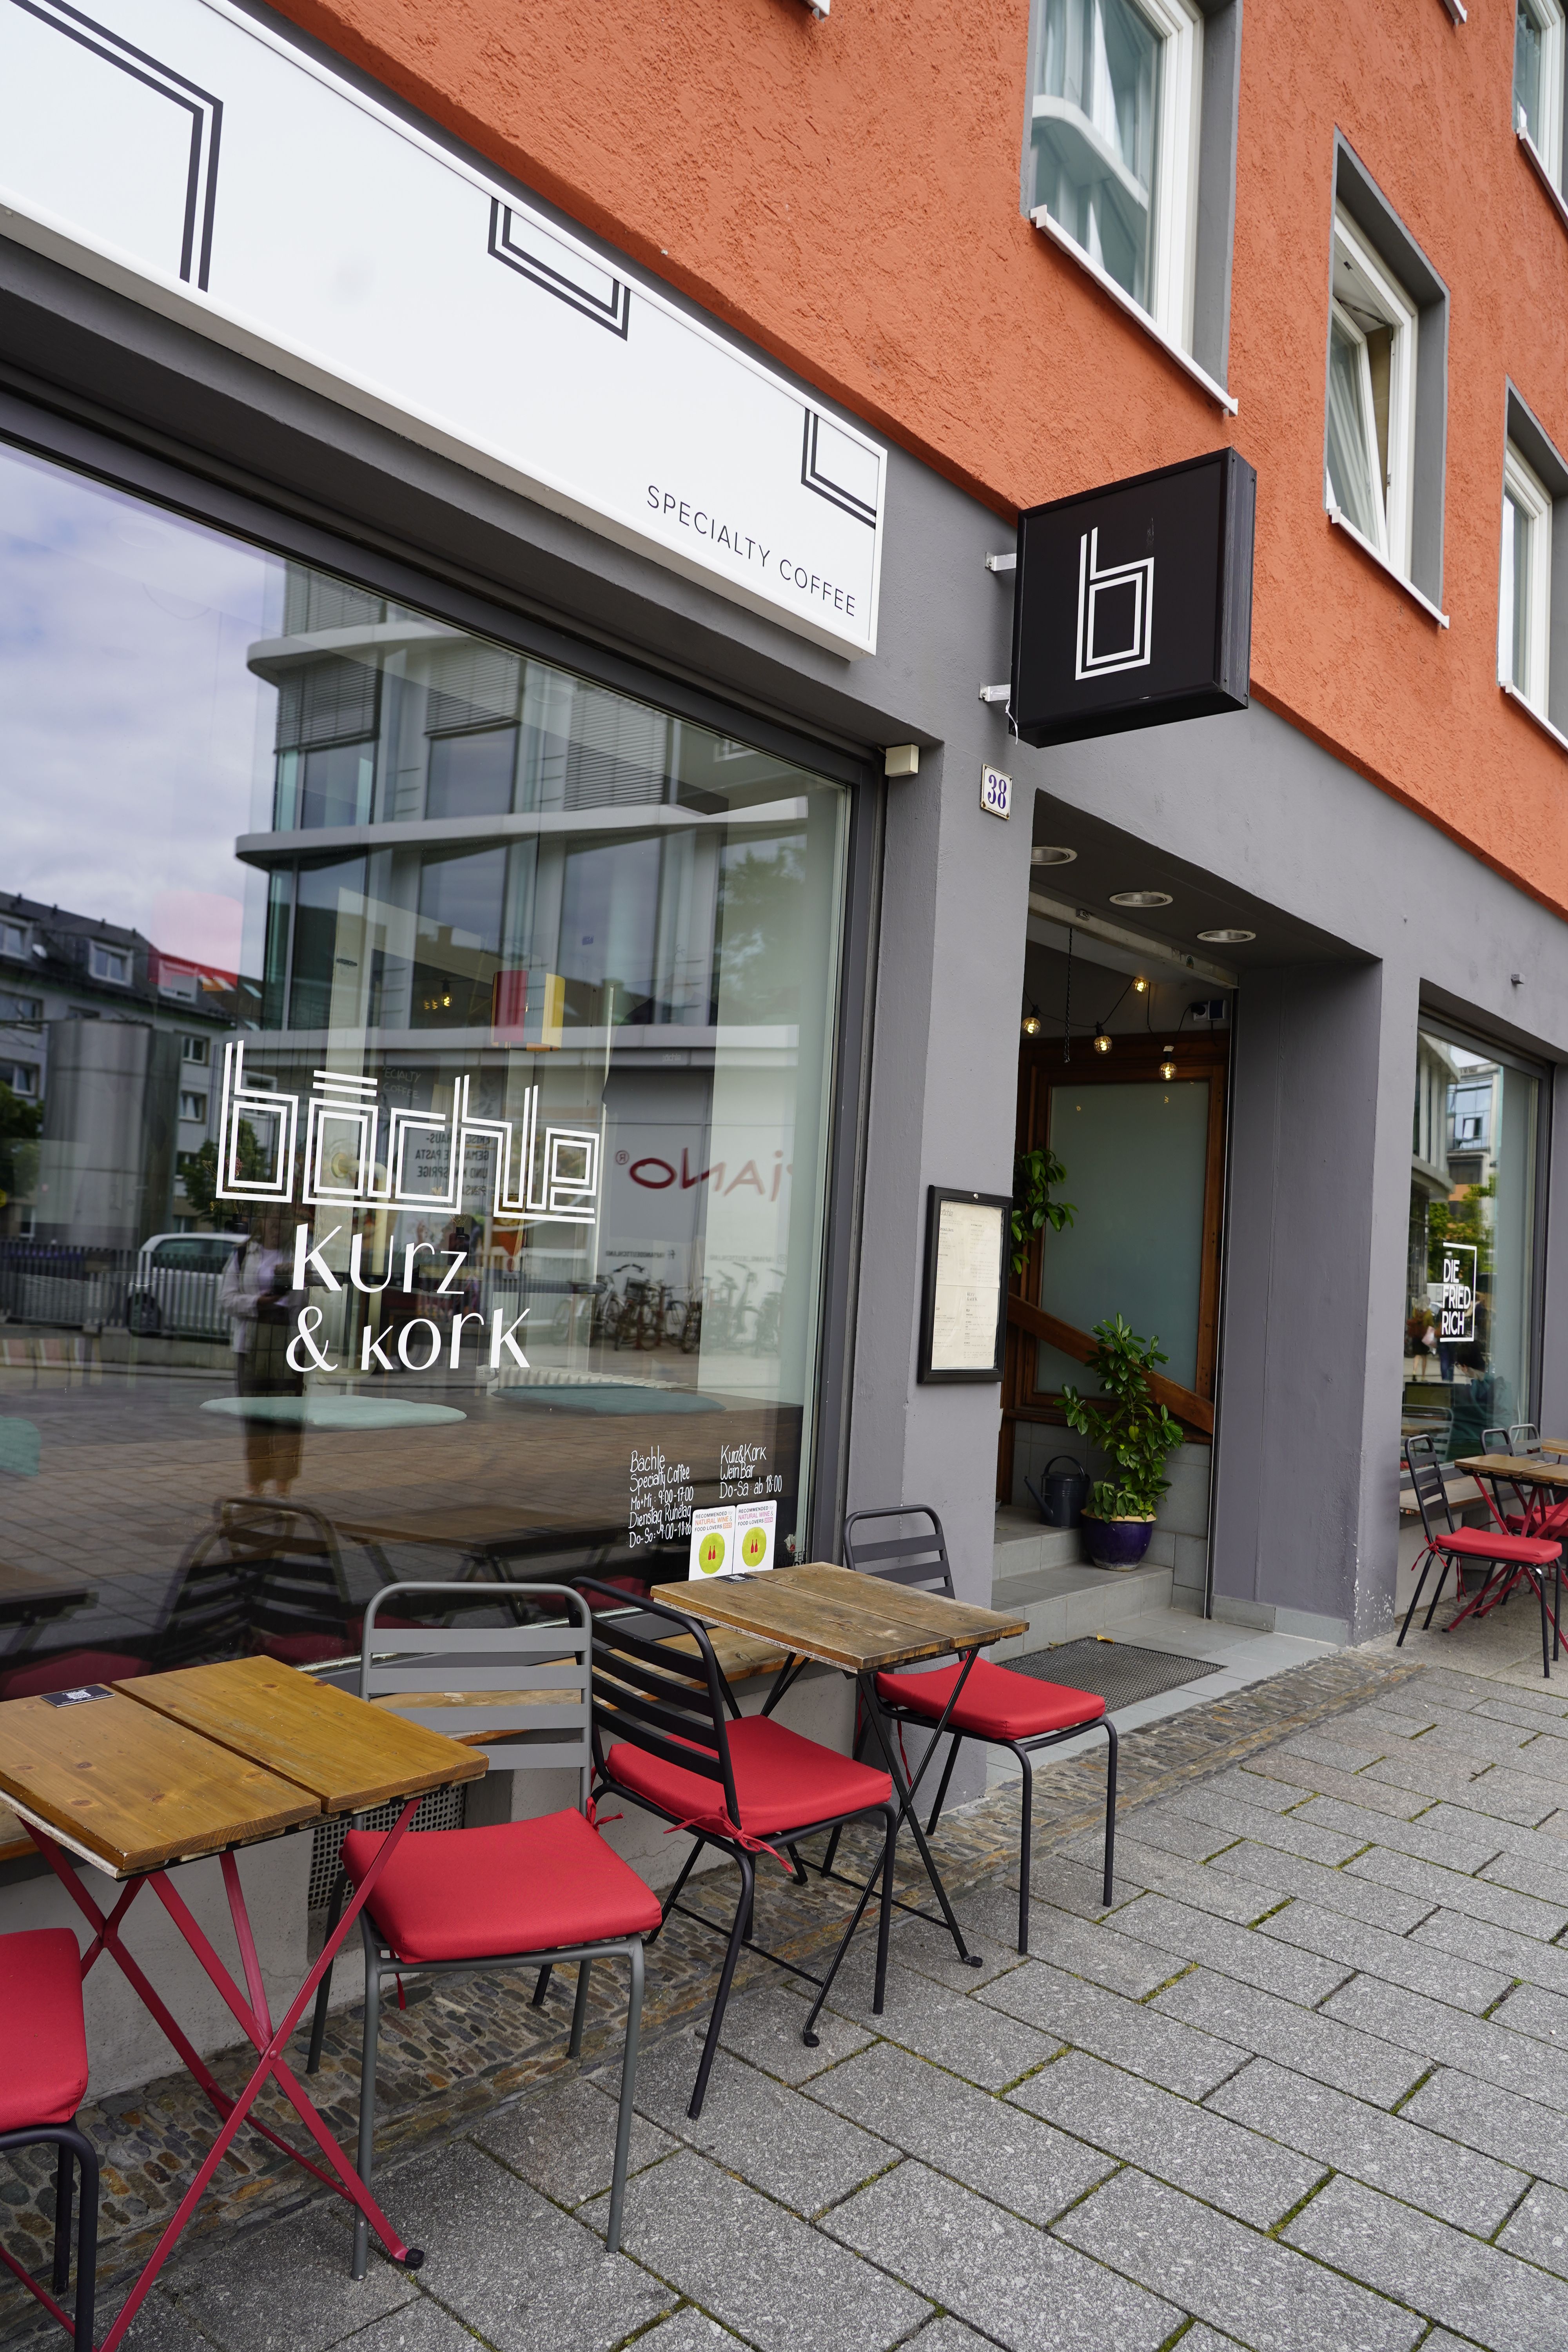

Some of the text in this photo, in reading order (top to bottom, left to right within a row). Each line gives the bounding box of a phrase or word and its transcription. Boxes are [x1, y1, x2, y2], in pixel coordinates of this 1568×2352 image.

[647, 485, 856, 617] SPECIALTY COFFEE
[987, 775, 1007, 809] 38
[383, 1065, 421, 1083] ECIALTY
[1443, 1259, 1460, 1283] DIE
[1443, 1285, 1471, 1309] FRIED
[1441, 1311, 1465, 1335] RICH
[286, 1305, 338, 1373] &
[630, 1445, 665, 1472] Bächle
[630, 1464, 690, 1496] Specialty Coffee
[754, 1477, 763, 1494] ab
[766, 1475, 782, 1493] 18:00
[628, 1501, 691, 1534] Dienstag Ruhetag
